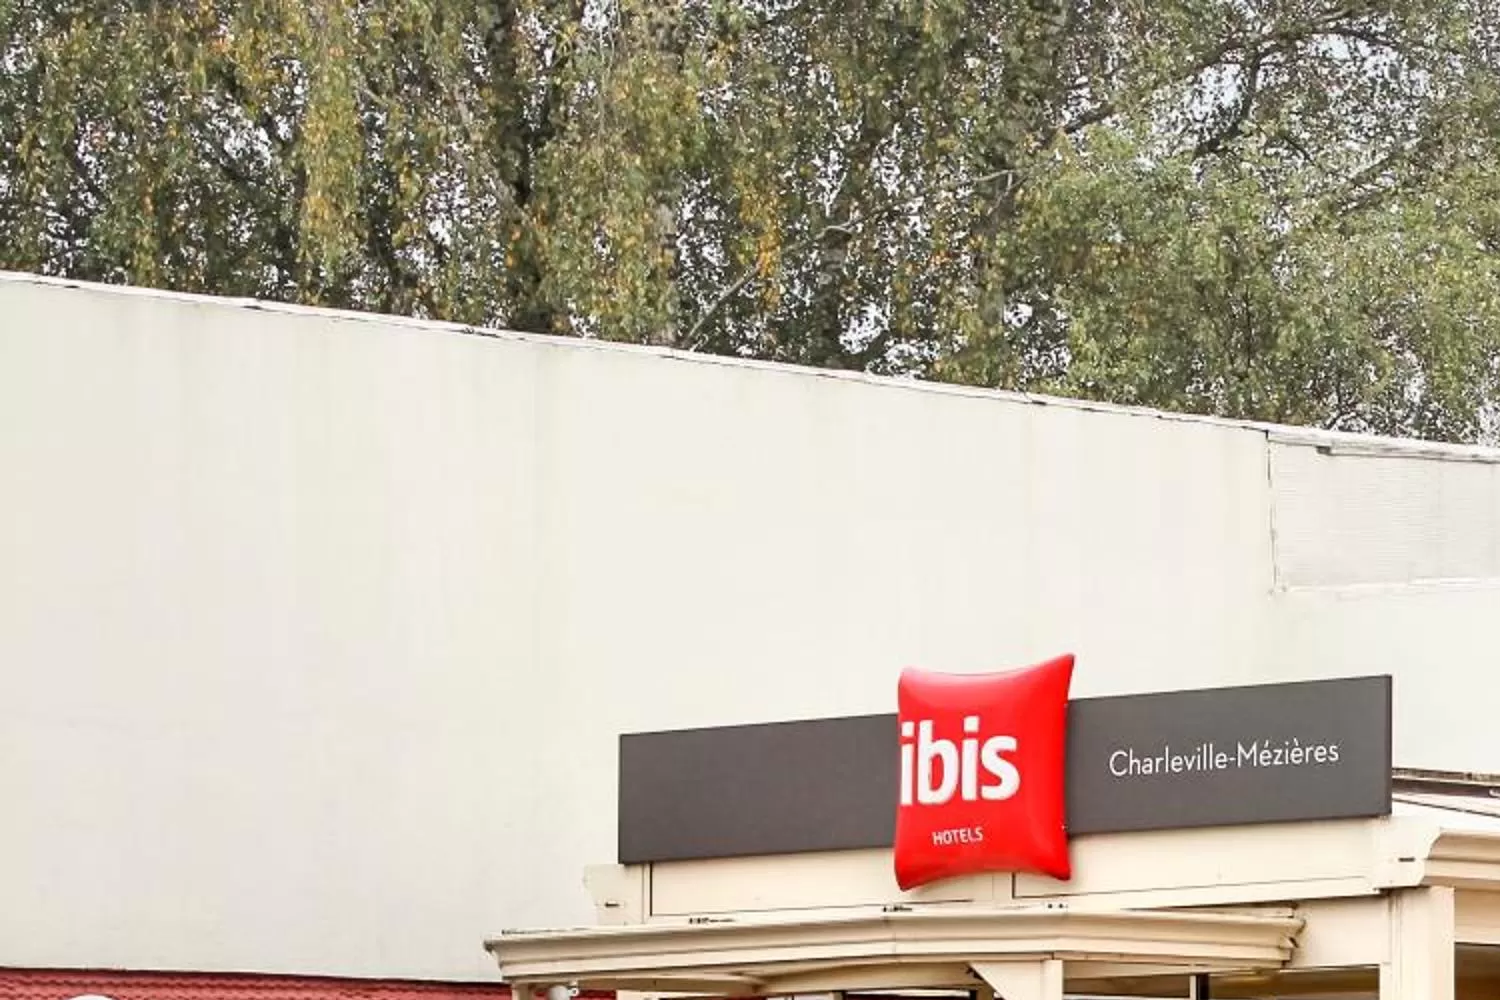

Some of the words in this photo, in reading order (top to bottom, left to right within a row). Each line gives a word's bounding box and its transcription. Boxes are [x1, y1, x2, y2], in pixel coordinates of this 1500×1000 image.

[901, 715, 1020, 806] ibis
[1108, 736, 1341, 777] Charleville-Mézières
[931, 827, 984, 846] HOTELS
